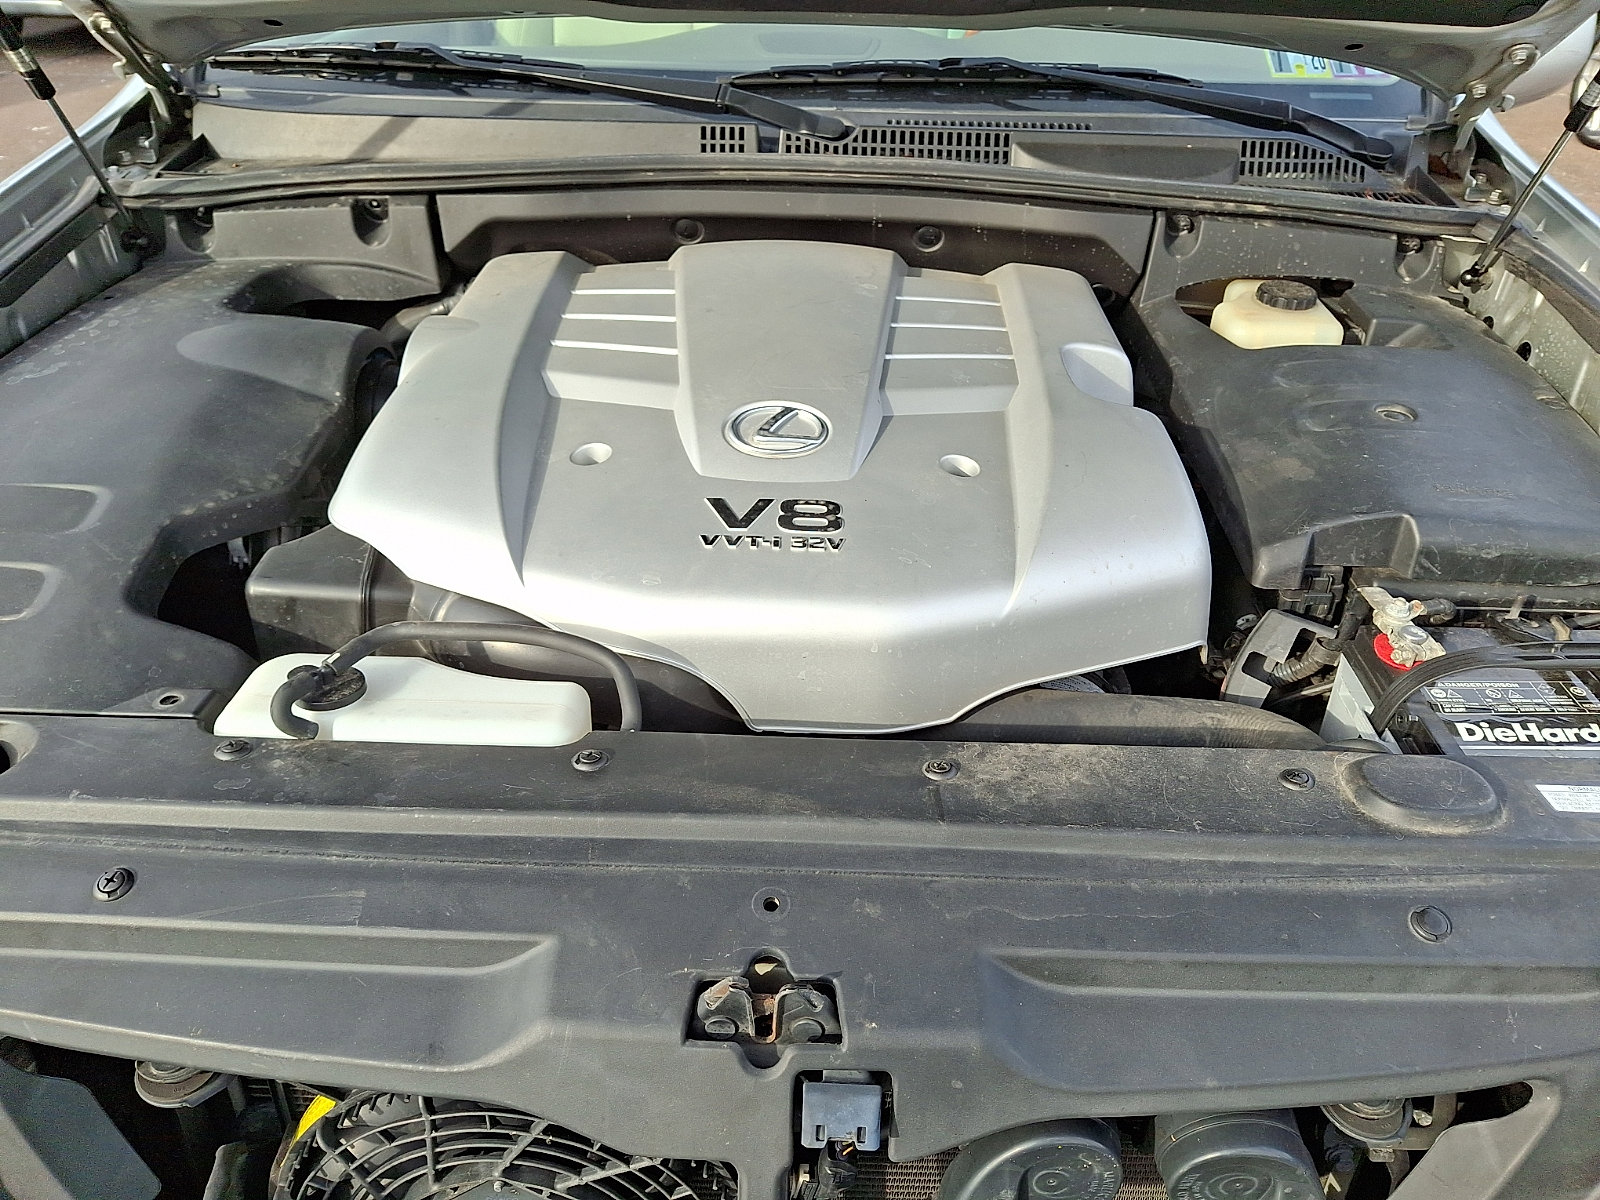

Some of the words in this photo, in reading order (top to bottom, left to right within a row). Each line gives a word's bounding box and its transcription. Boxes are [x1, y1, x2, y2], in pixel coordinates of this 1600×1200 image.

[703, 497, 844, 533] V8
[699, 534, 782, 550] VVT-i
[789, 536, 847, 552] 32V
[1456, 722, 1600, 743] DieHard
